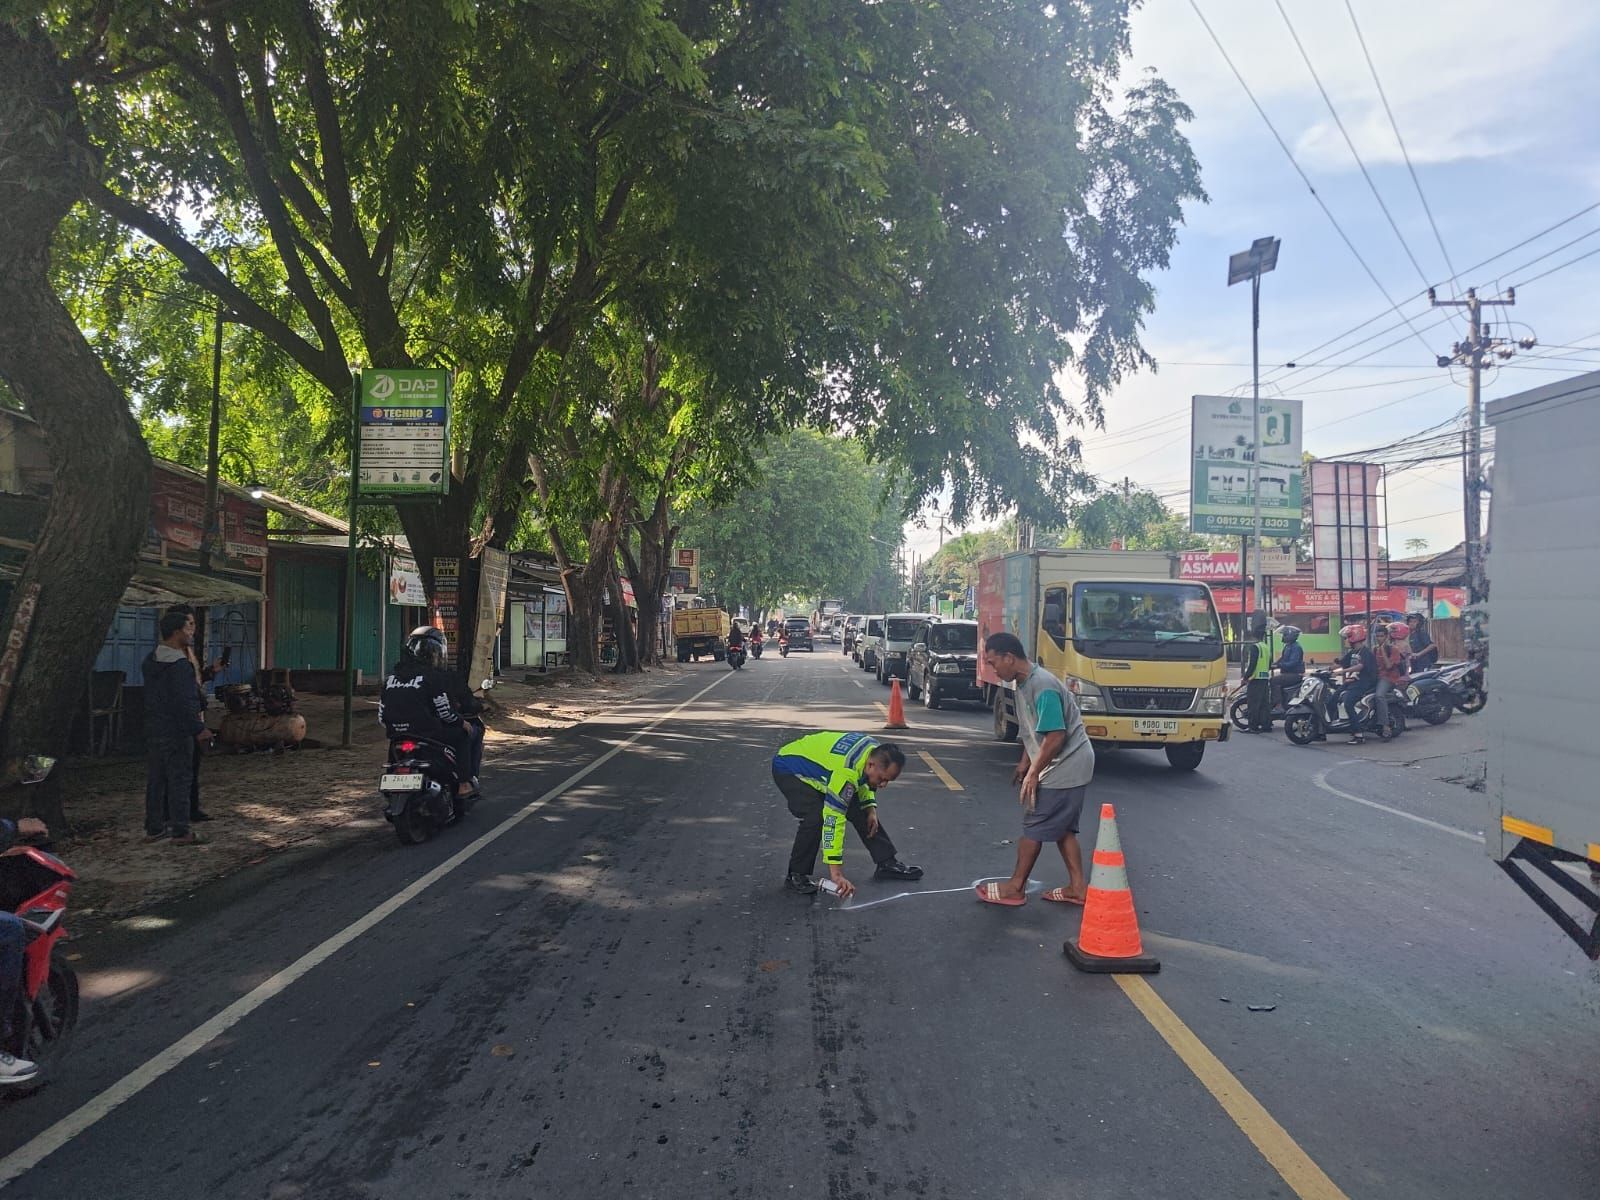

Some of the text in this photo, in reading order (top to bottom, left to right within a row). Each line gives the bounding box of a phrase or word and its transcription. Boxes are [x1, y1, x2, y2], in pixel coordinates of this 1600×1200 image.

[398, 379, 438, 392] DAP
[383, 409, 433, 418] TECHNO 2
[1216, 516, 1238, 525] 0812
[1265, 519, 1289, 528] 8303
[438, 568, 455, 576] ATK
